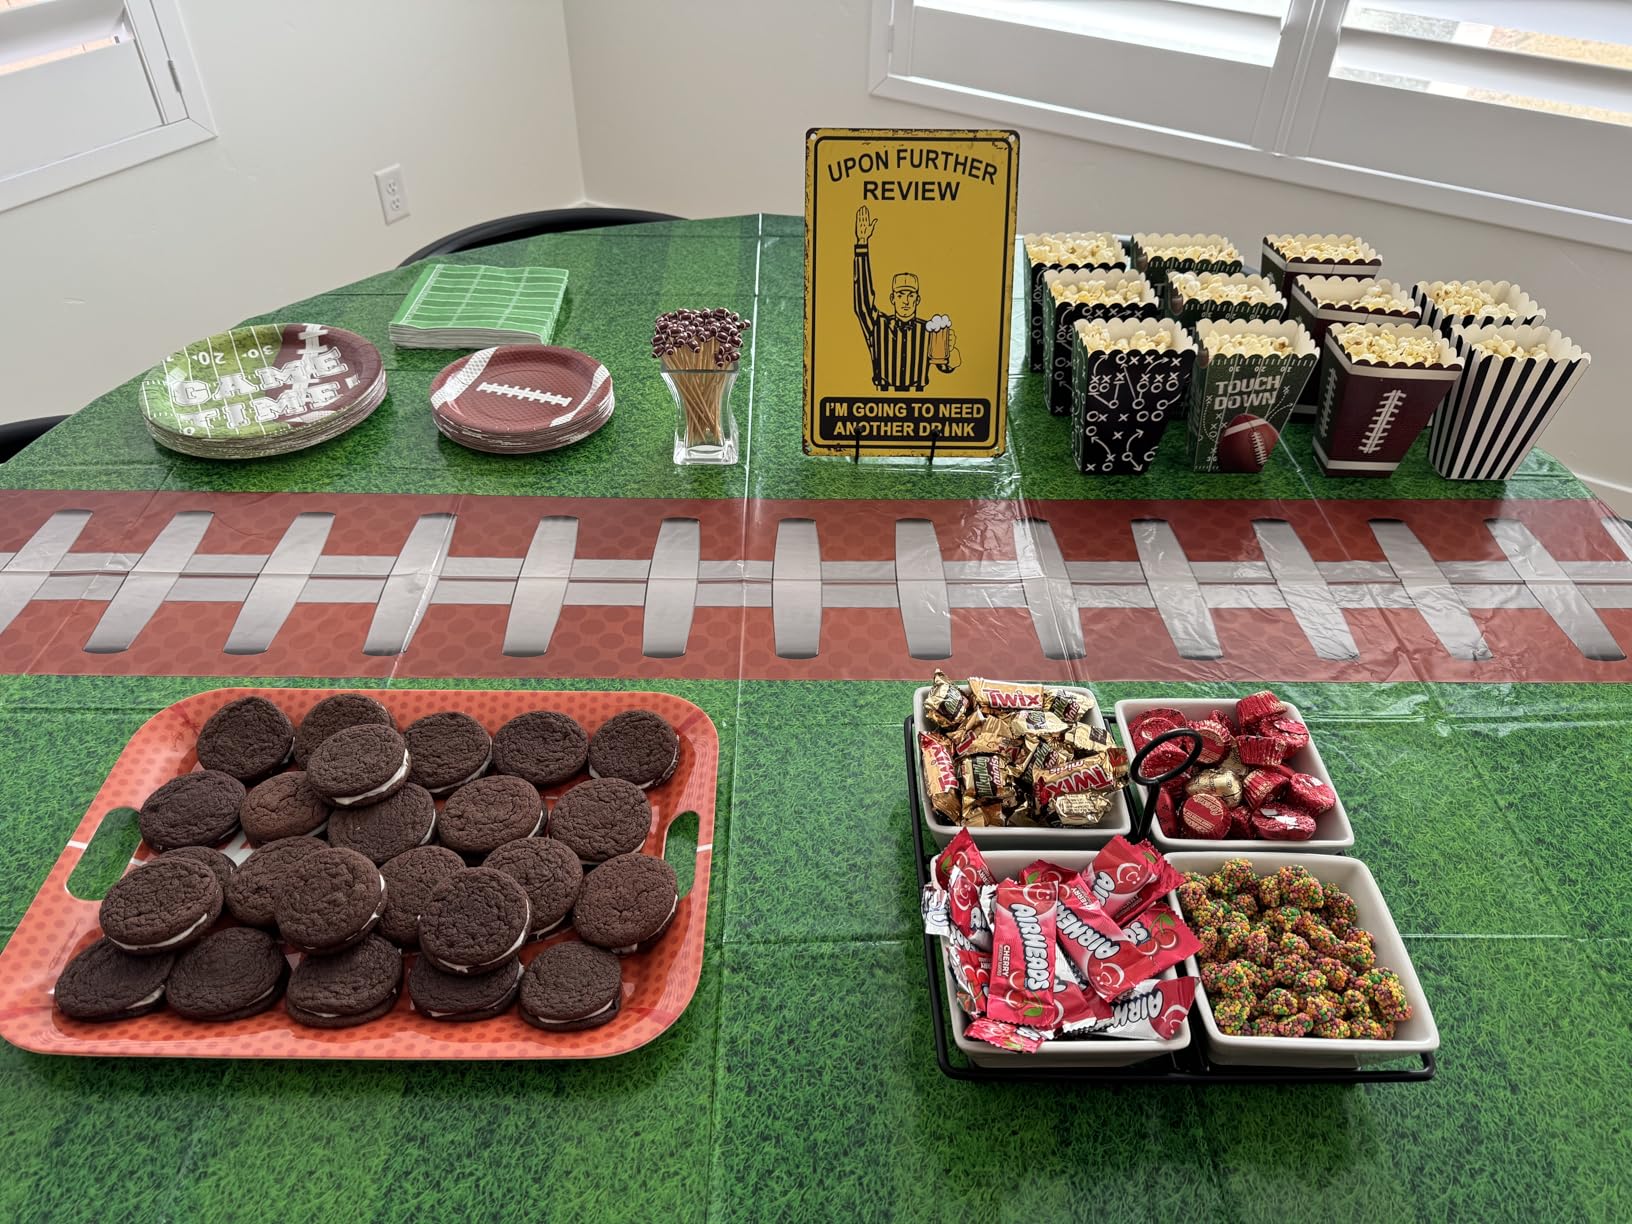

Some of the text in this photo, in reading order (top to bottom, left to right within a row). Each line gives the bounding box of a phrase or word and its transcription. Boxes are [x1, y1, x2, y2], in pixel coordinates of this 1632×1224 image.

[828, 148, 998, 185] UPON FURTHER
[863, 180, 961, 201] REVIEW
[171, 346, 349, 407] GAME
[1215, 375, 1281, 395] TOUCH
[177, 381, 343, 430] TIME
[825, 402, 985, 418] I'M GOING TO NEED
[1213, 391, 1278, 410] DOWN
[833, 421, 915, 437] ANOTHER
[1009, 902, 1051, 992] AIRHEADS
[1002, 944, 1011, 978] CHERRY
